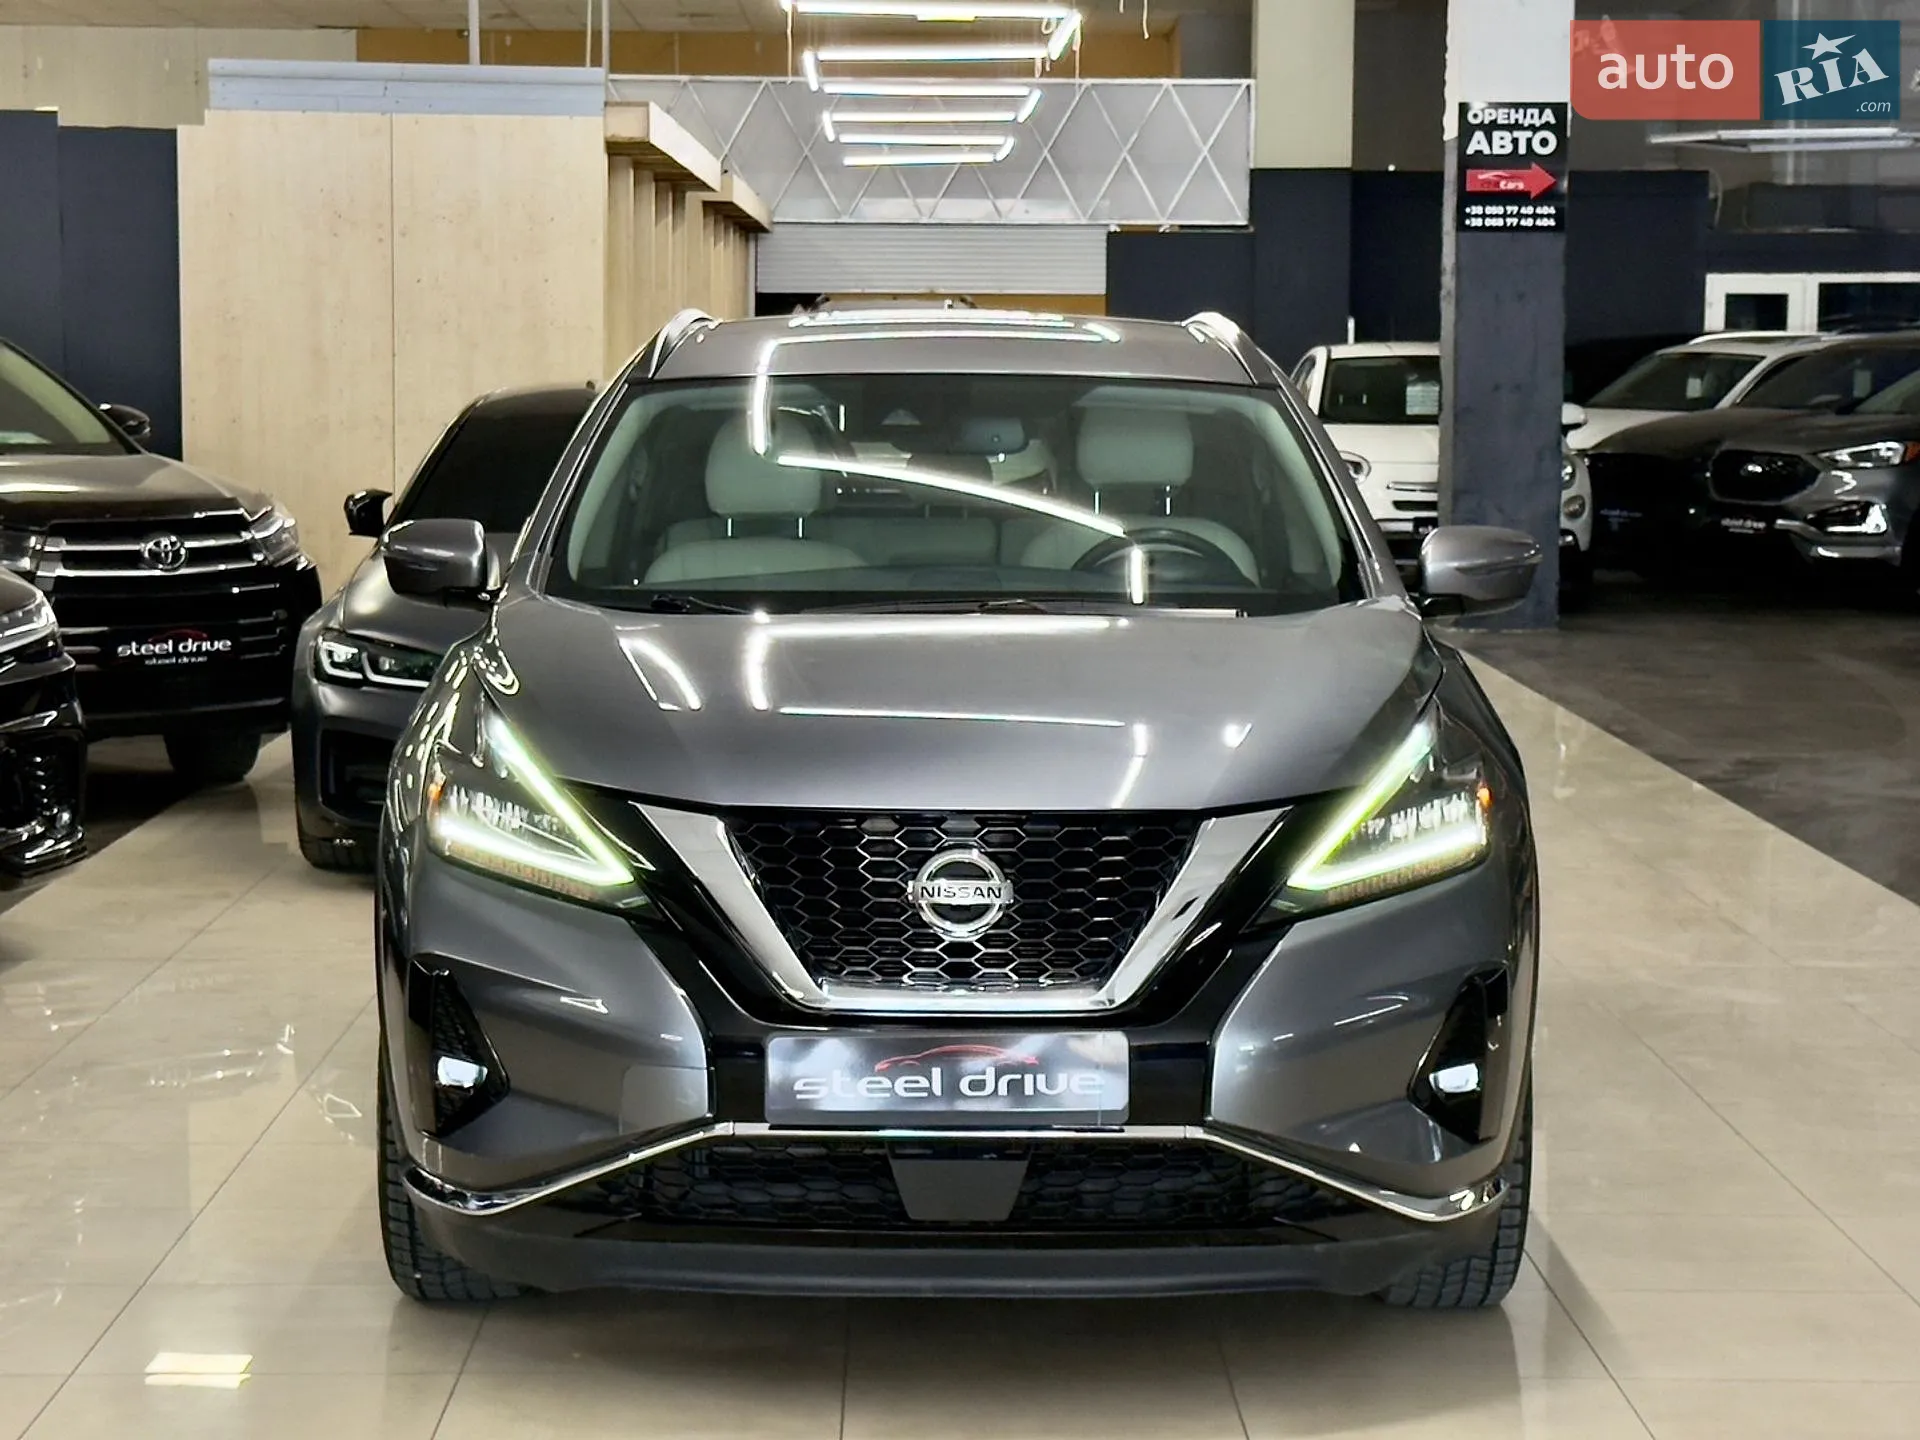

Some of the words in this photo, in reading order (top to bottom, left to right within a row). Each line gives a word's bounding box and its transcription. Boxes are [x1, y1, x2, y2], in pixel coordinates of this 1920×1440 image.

[1467, 108, 1556, 127] ОРЕНДА
[1466, 130, 1557, 155] АВТО
[117, 639, 173, 657] steel
[178, 637, 232, 653] drive
[920, 886, 1002, 899] NISSAN
[793, 1066, 943, 1100] steel
[958, 1066, 1106, 1097] drive
